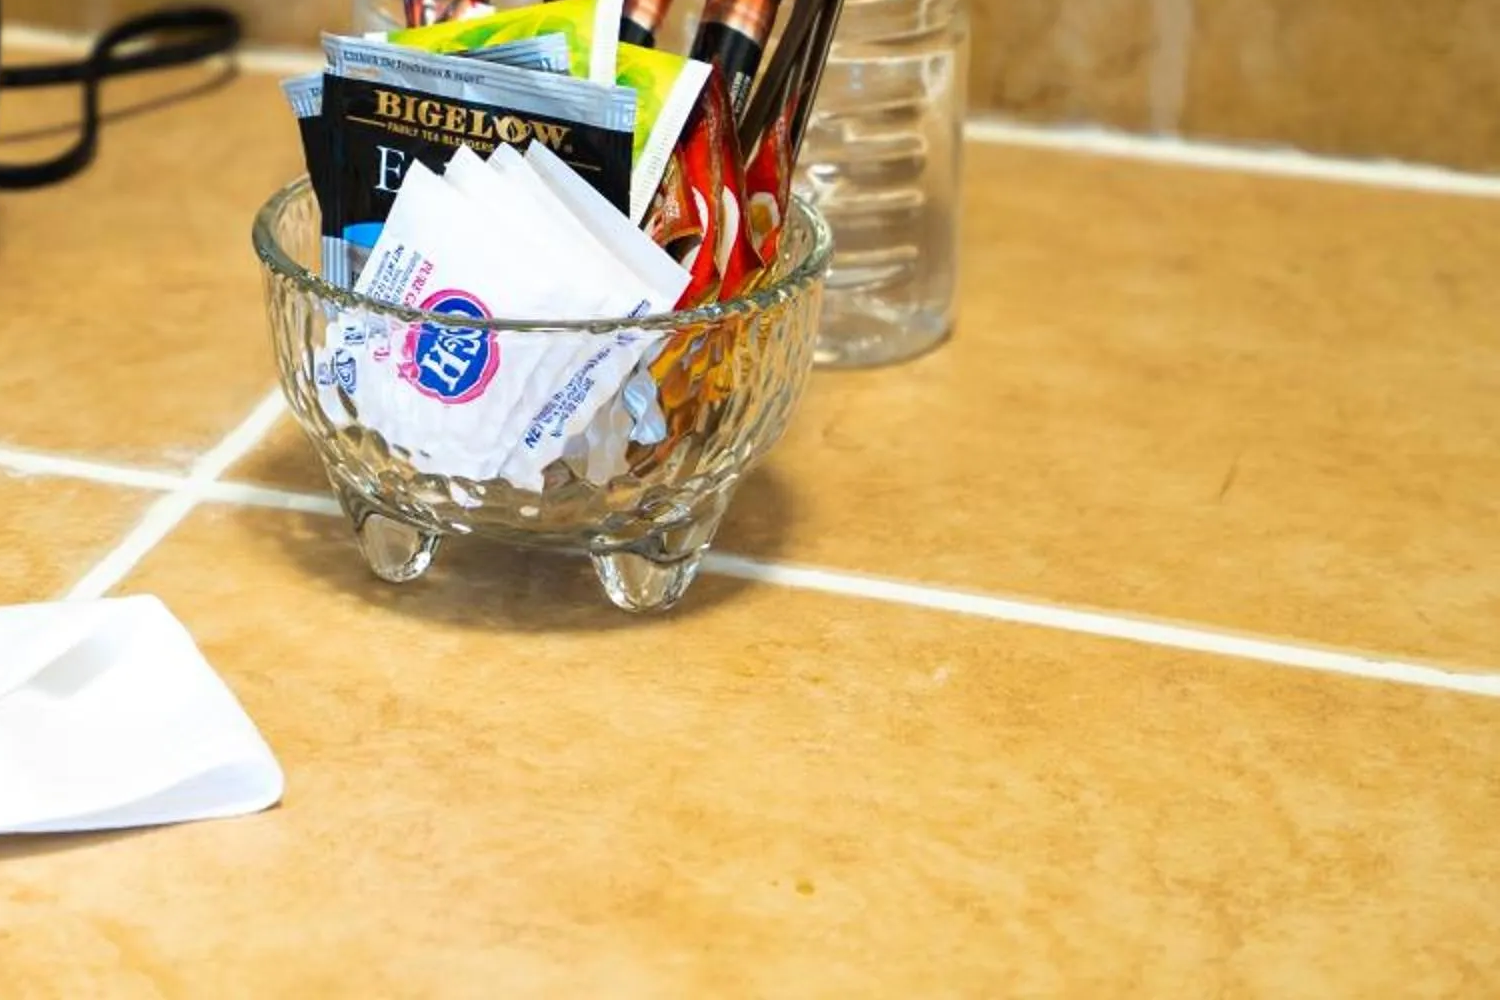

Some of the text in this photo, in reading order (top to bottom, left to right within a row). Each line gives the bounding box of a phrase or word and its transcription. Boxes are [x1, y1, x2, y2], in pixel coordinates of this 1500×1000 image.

[374, 89, 571, 151] BIGELOW
[387, 121, 418, 137] FAMILY
[421, 128, 440, 143] TEA
